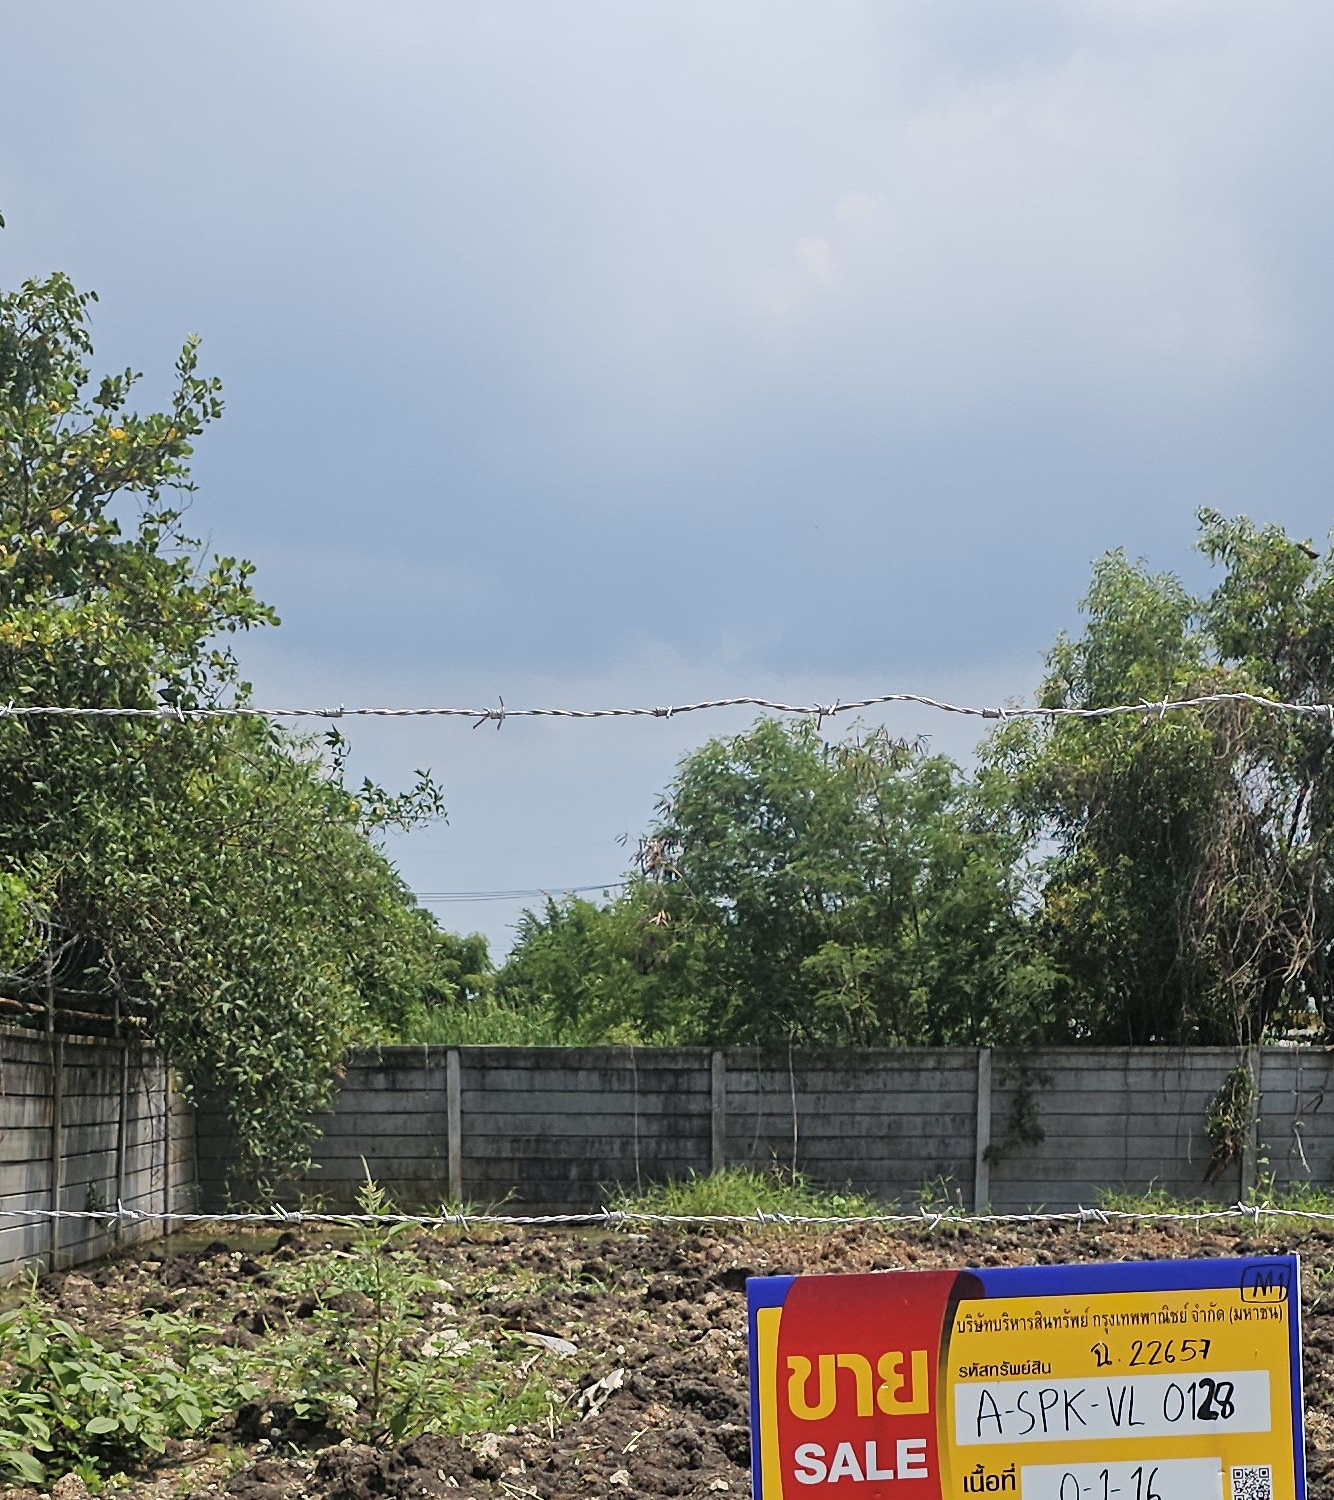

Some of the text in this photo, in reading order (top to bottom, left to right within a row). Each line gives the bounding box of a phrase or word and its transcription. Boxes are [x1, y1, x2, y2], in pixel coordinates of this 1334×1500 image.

[956, 1303, 1283, 1335] บริษัทบริหารสินทรัพย์ กรุงเทพพาณิชย์ จำกัด (มหาชน)
[958, 1360, 1052, 1378] รหัสทรัพย์สิน
[1128, 1339, 1211, 1367] 22657
[787, 1350, 930, 1420] ขาย
[1163, 1378, 1236, 1423] 0128
[794, 1438, 929, 1485] SALE
[963, 1463, 1016, 1493] เนื้อที่
